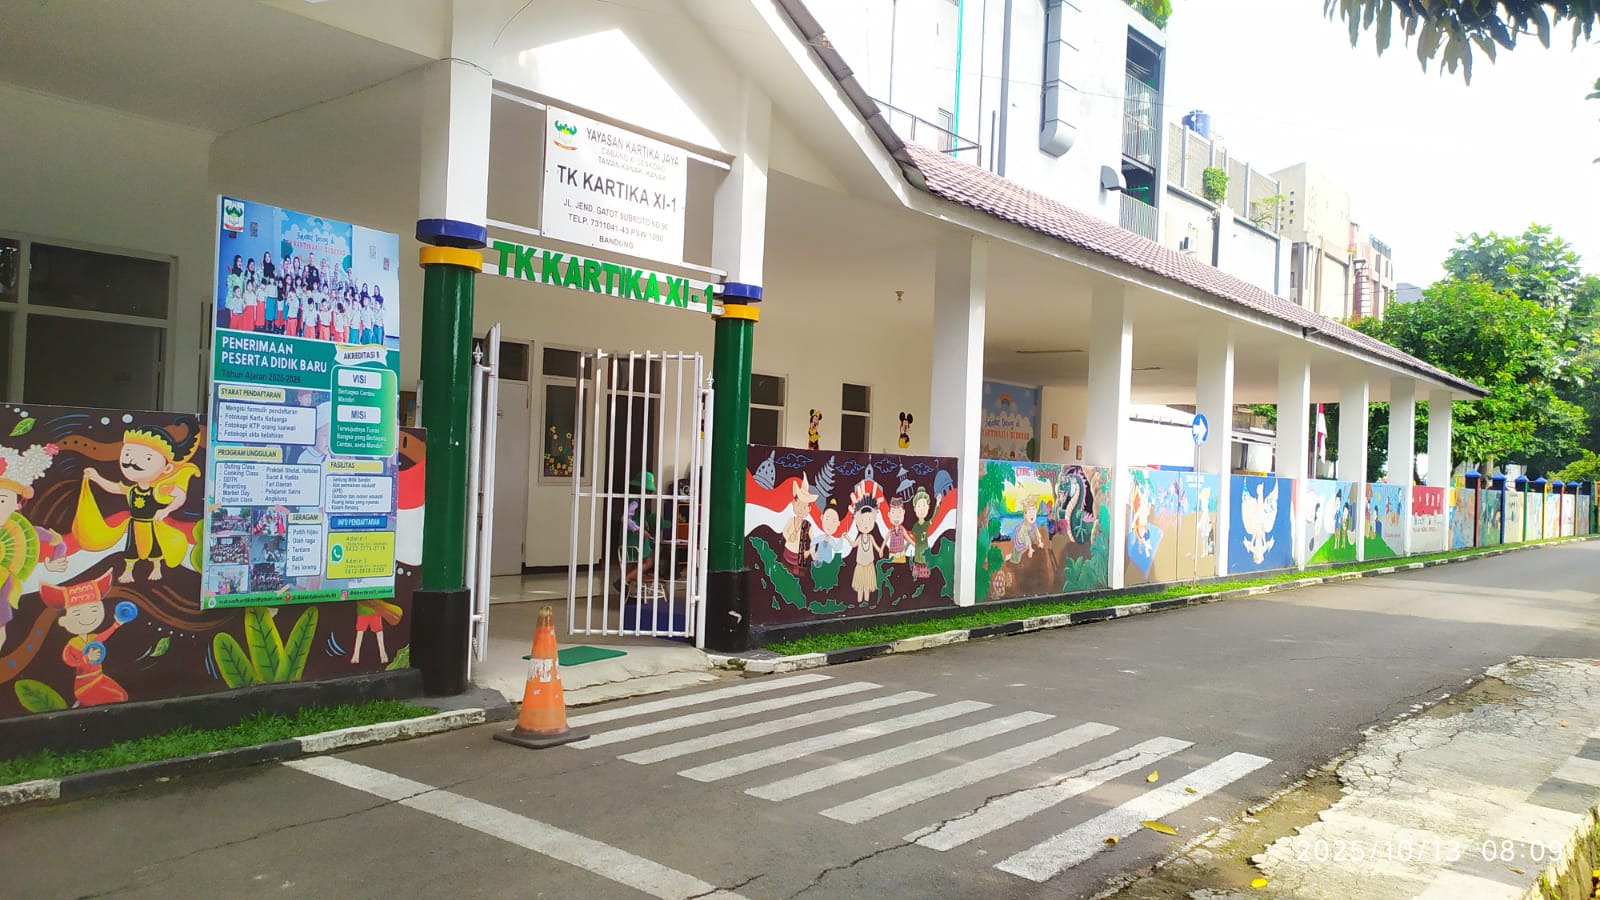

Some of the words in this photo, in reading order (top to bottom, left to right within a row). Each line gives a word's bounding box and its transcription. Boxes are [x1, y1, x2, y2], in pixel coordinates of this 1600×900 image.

[587, 128, 623, 149] YAYASAN
[626, 142, 660, 160] KARTIKA
[662, 152, 679, 166] JAYA
[557, 165, 577, 187] TK
[583, 172, 649, 206] KARTIKA
[653, 192, 676, 212] XI-1
[596, 206, 618, 218] GATOT
[599, 236, 634, 249] BANDUNG
[493, 240, 536, 282] TK
[541, 250, 660, 303] KARTIKA
[222, 336, 294, 354] PENERIMAAN
[222, 352, 268, 367] PESERTA
[270, 356, 298, 370] DIDIK
[300, 360, 327, 373] BARU
[344, 352, 375, 360] AKREDITASI
[353, 374, 366, 384] VISI
[243, 389, 281, 398] PENDAFTARAN
[351, 410, 366, 420] MISI
